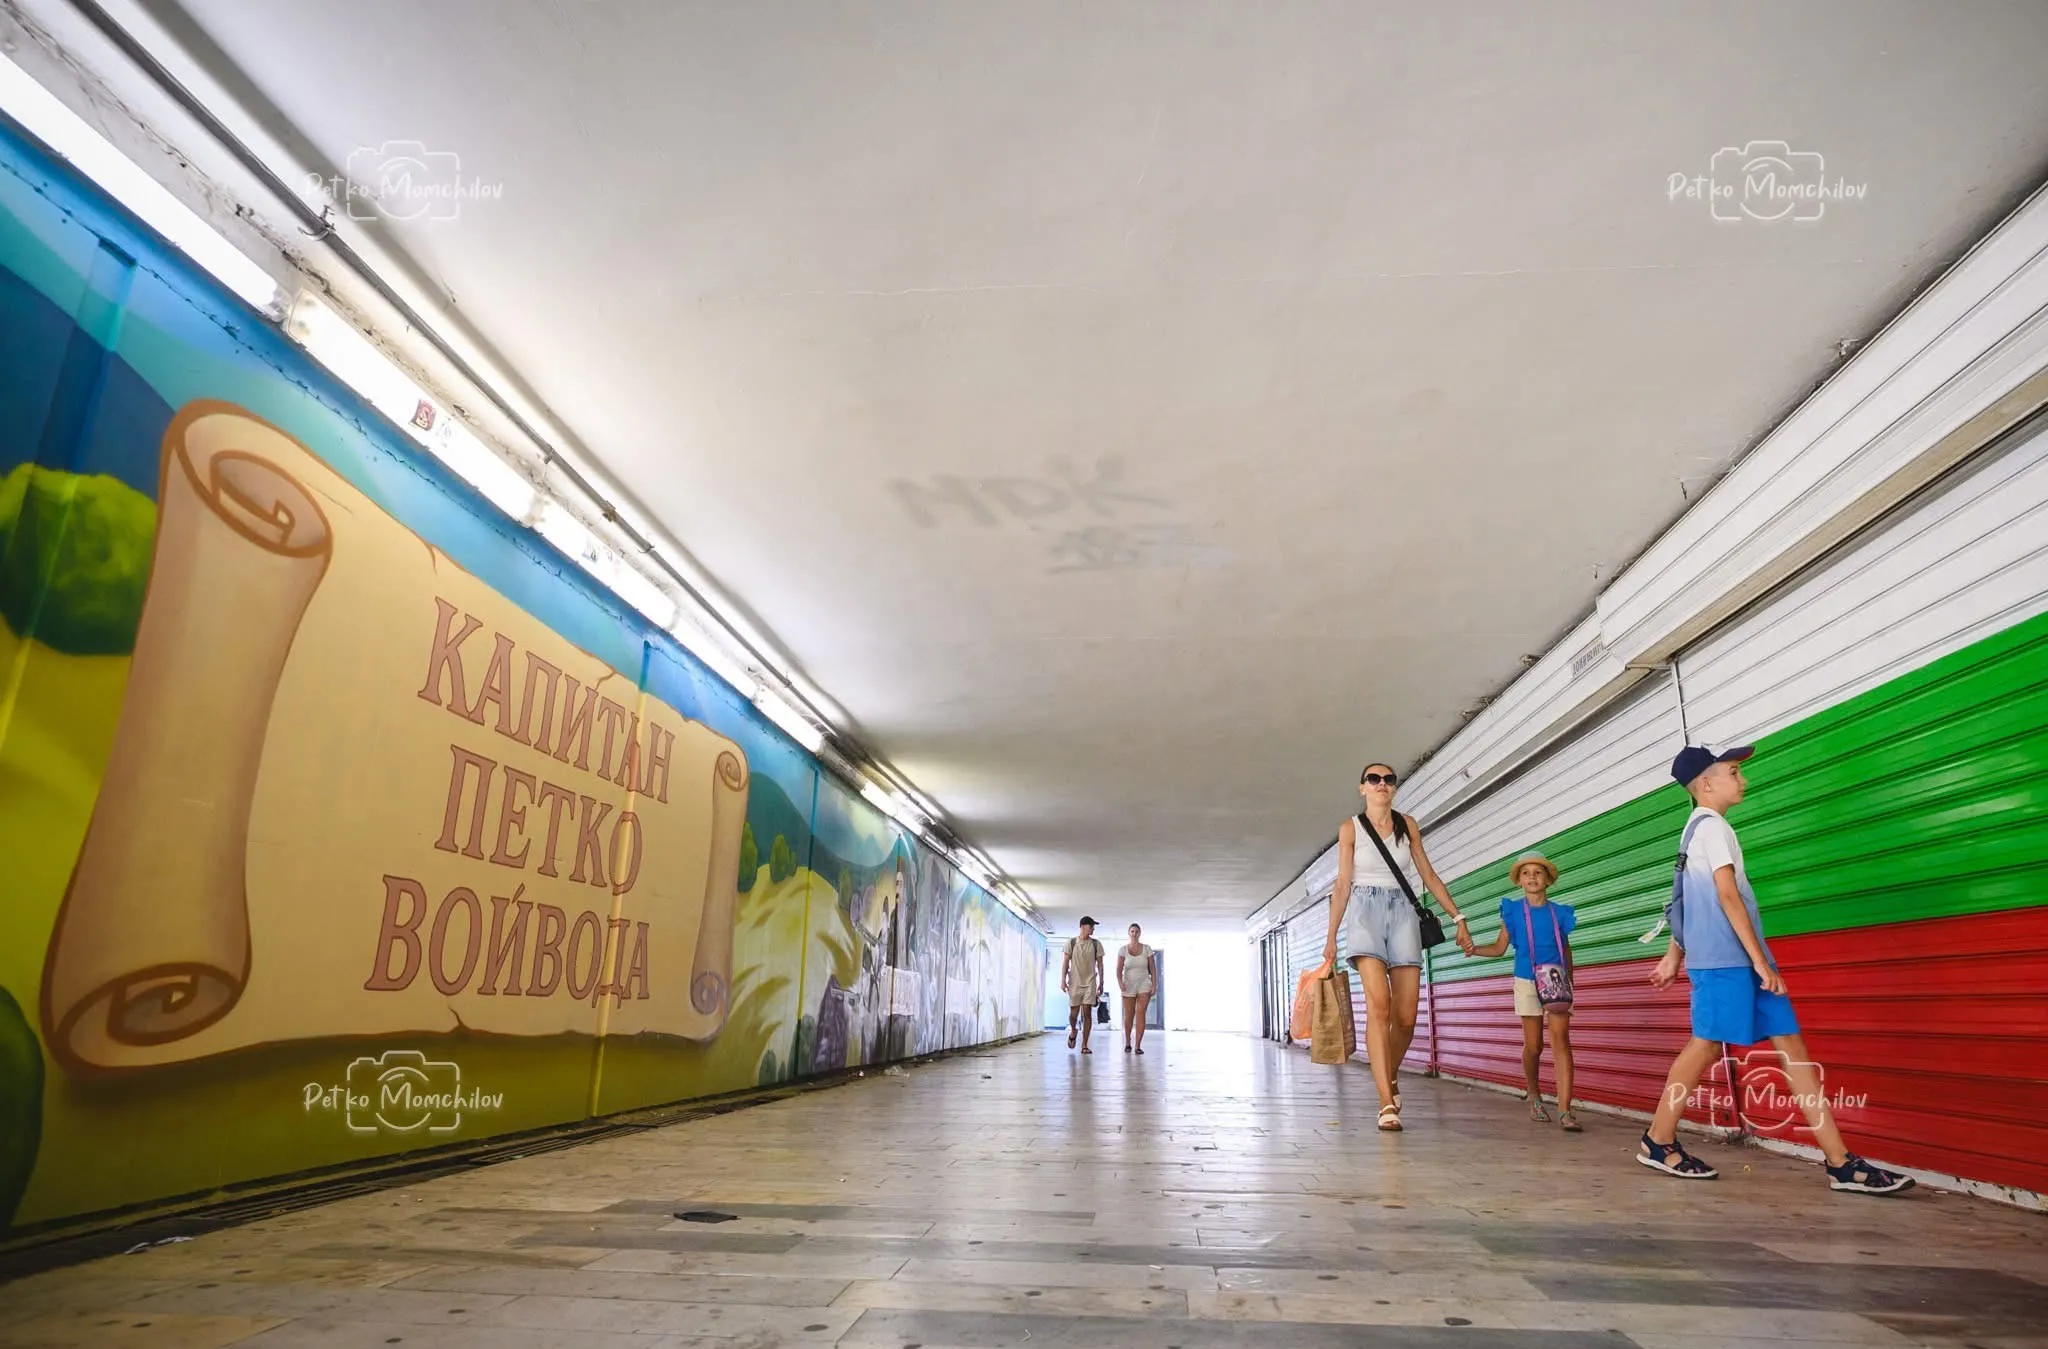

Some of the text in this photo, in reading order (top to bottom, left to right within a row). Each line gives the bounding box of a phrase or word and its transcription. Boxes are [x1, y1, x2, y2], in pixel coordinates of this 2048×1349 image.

[417, 596, 676, 804] КАПИТАН
[434, 744, 643, 896] ПЕТКО
[364, 874, 650, 1009] ВОЙВОДА
